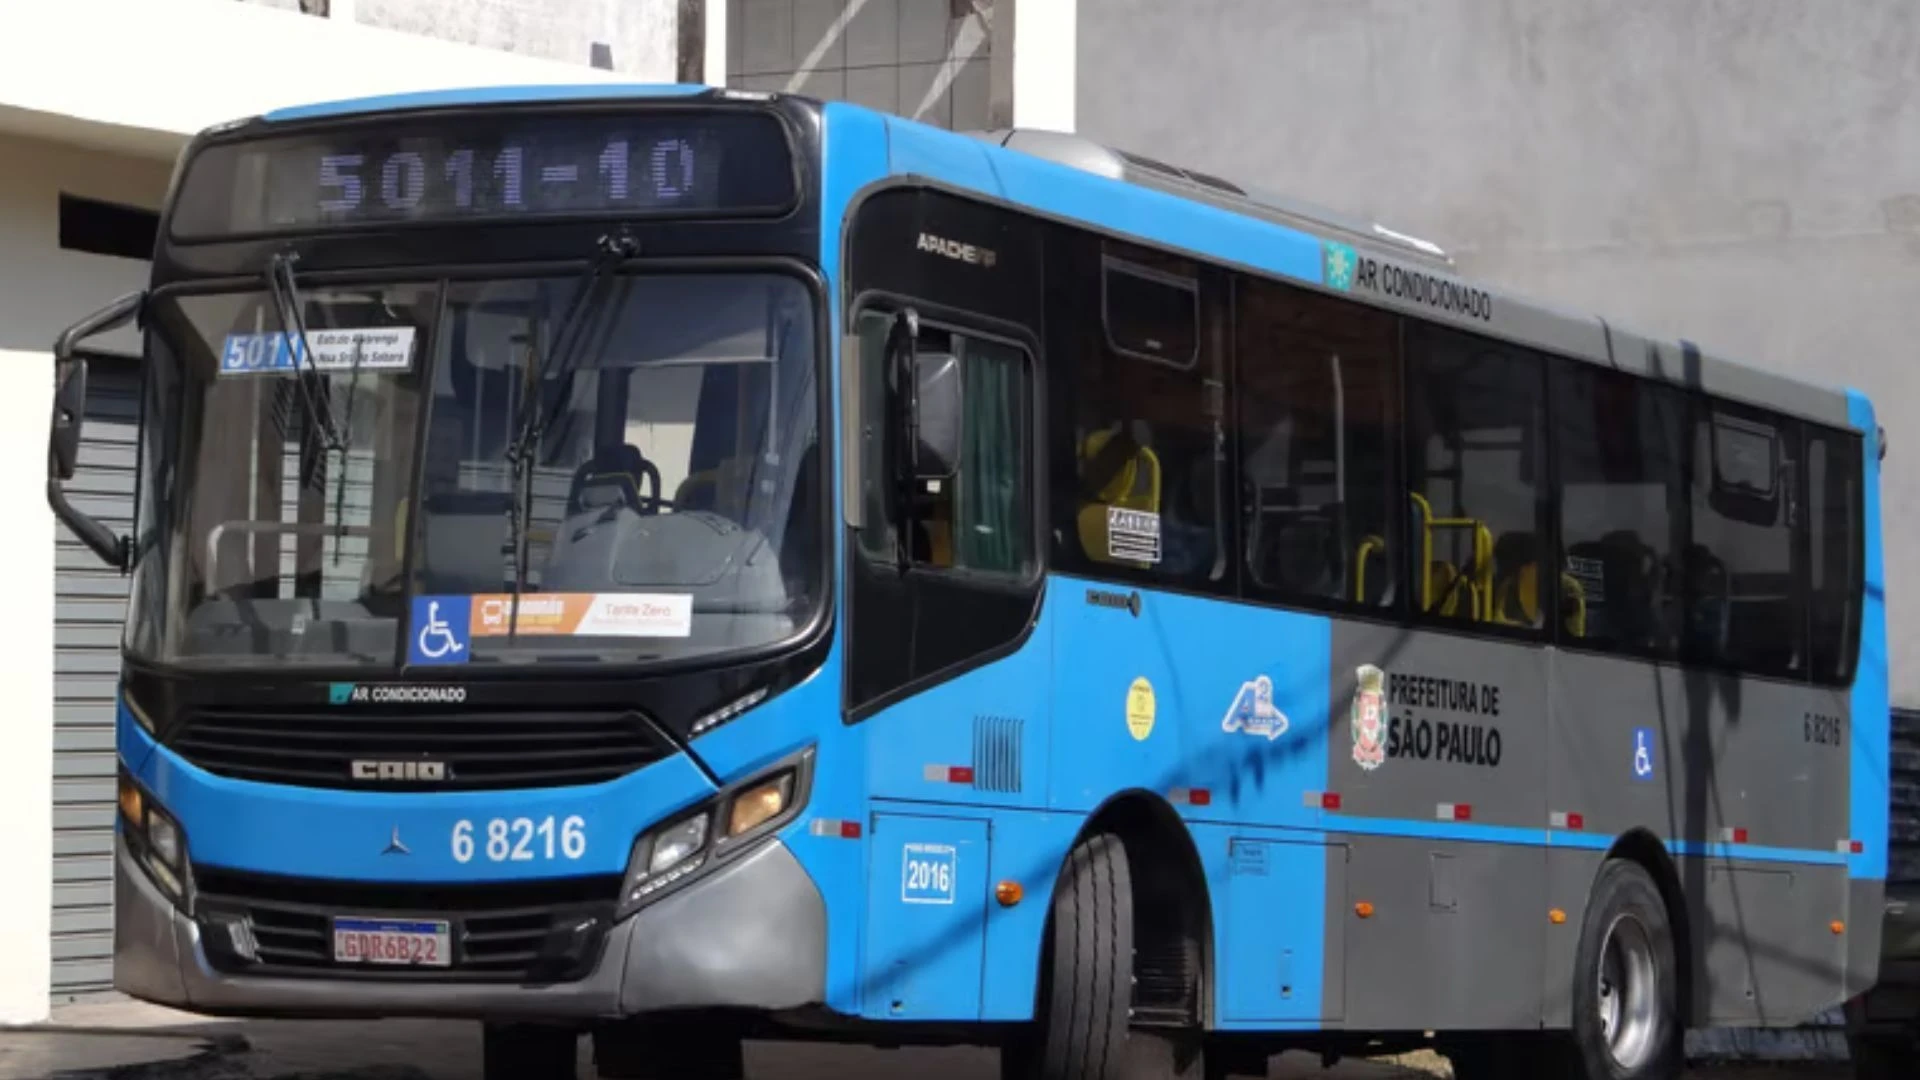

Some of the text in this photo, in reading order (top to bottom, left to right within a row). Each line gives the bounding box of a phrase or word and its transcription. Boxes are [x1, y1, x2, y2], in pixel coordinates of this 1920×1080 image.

[319, 139, 694, 210] 5011-10
[1357, 256, 1492, 322] AR CONDICIONADO
[352, 686, 467, 703] AR CONDICIONADO
[1390, 673, 1500, 716] PREFEITURA DE
[1388, 709, 1501, 767] SÃO PAULO
[1804, 711, 1811, 743] 6
[452, 815, 586, 864] 6 8216
[907, 860, 950, 892] 2016
